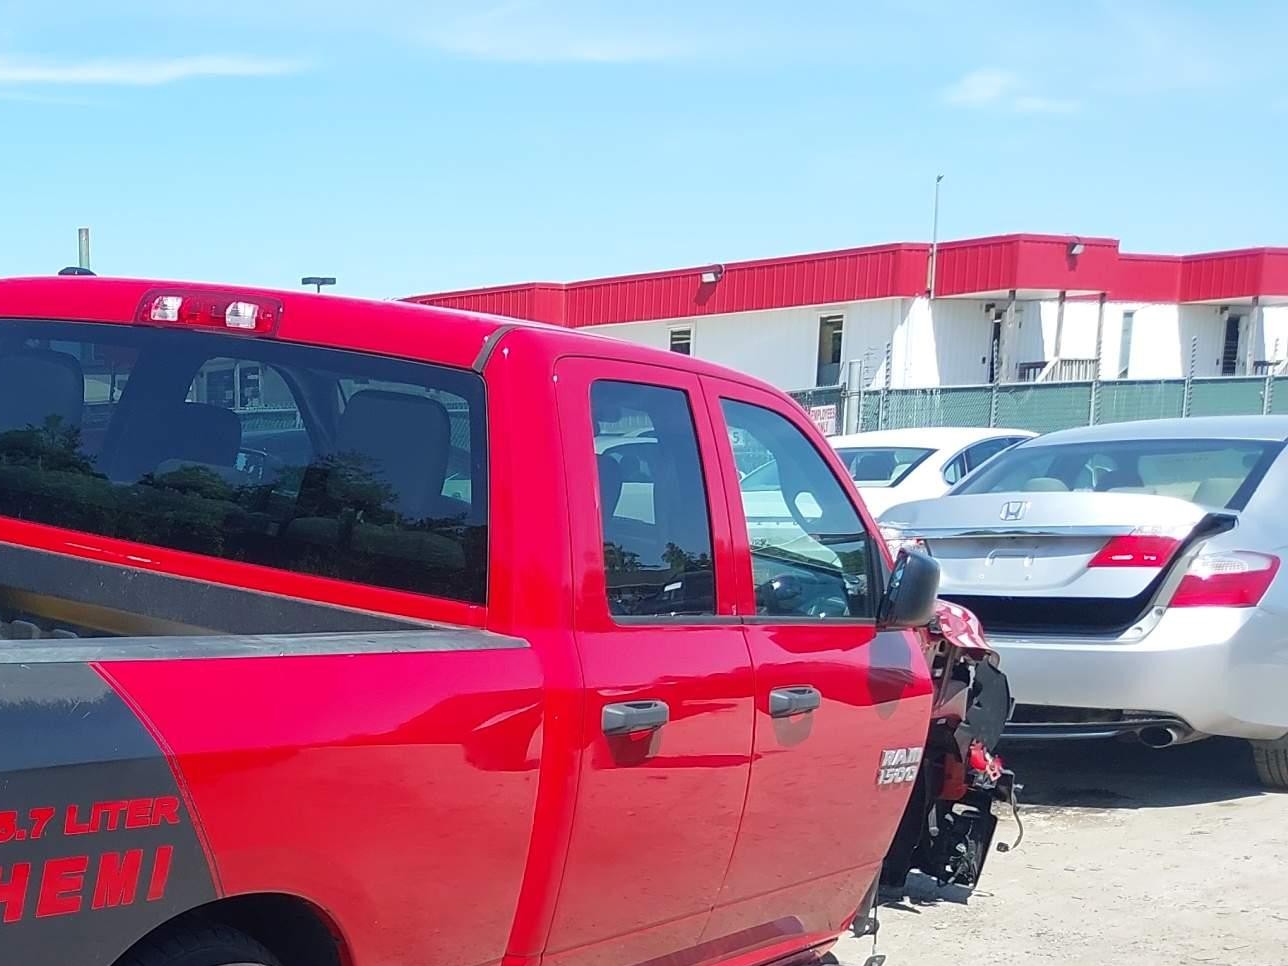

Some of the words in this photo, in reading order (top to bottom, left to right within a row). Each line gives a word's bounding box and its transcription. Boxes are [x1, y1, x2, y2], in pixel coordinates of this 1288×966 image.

[811, 407, 835, 421] EMPLOYEES
[881, 747, 924, 768] RAM
[877, 766, 918, 785] 1500
[64, 795, 181, 835] LITER
